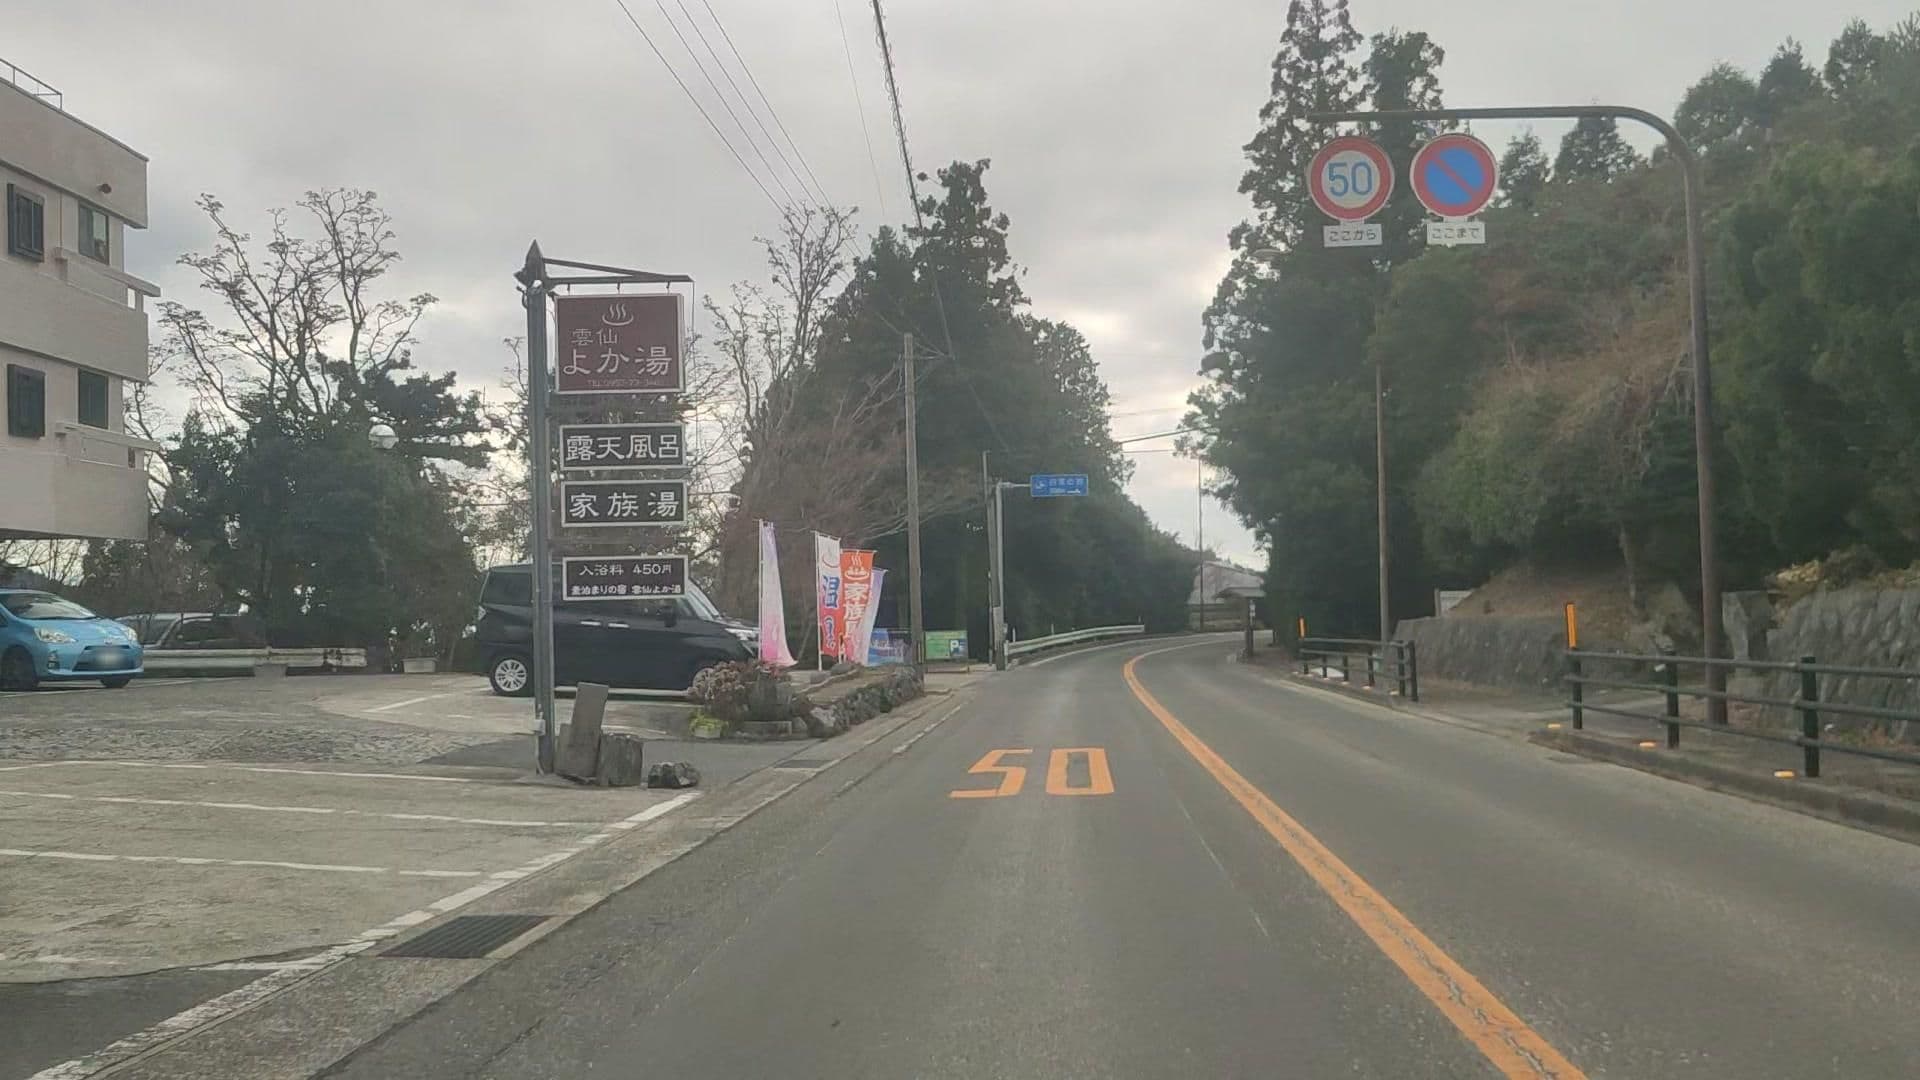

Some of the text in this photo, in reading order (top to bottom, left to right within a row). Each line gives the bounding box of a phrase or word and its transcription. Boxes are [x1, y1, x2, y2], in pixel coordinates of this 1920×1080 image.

[1328, 161, 1373, 198] 50
[1329, 230, 1377, 242] ここから
[1431, 227, 1480, 240] ここまで
[571, 328, 618, 346] 雲仙
[563, 346, 673, 376] よか湯
[565, 434, 680, 462] 露天風呂
[569, 491, 679, 518] 家族湯
[579, 563, 672, 576] 入浴料 450円
[949, 748, 1115, 798] 50
